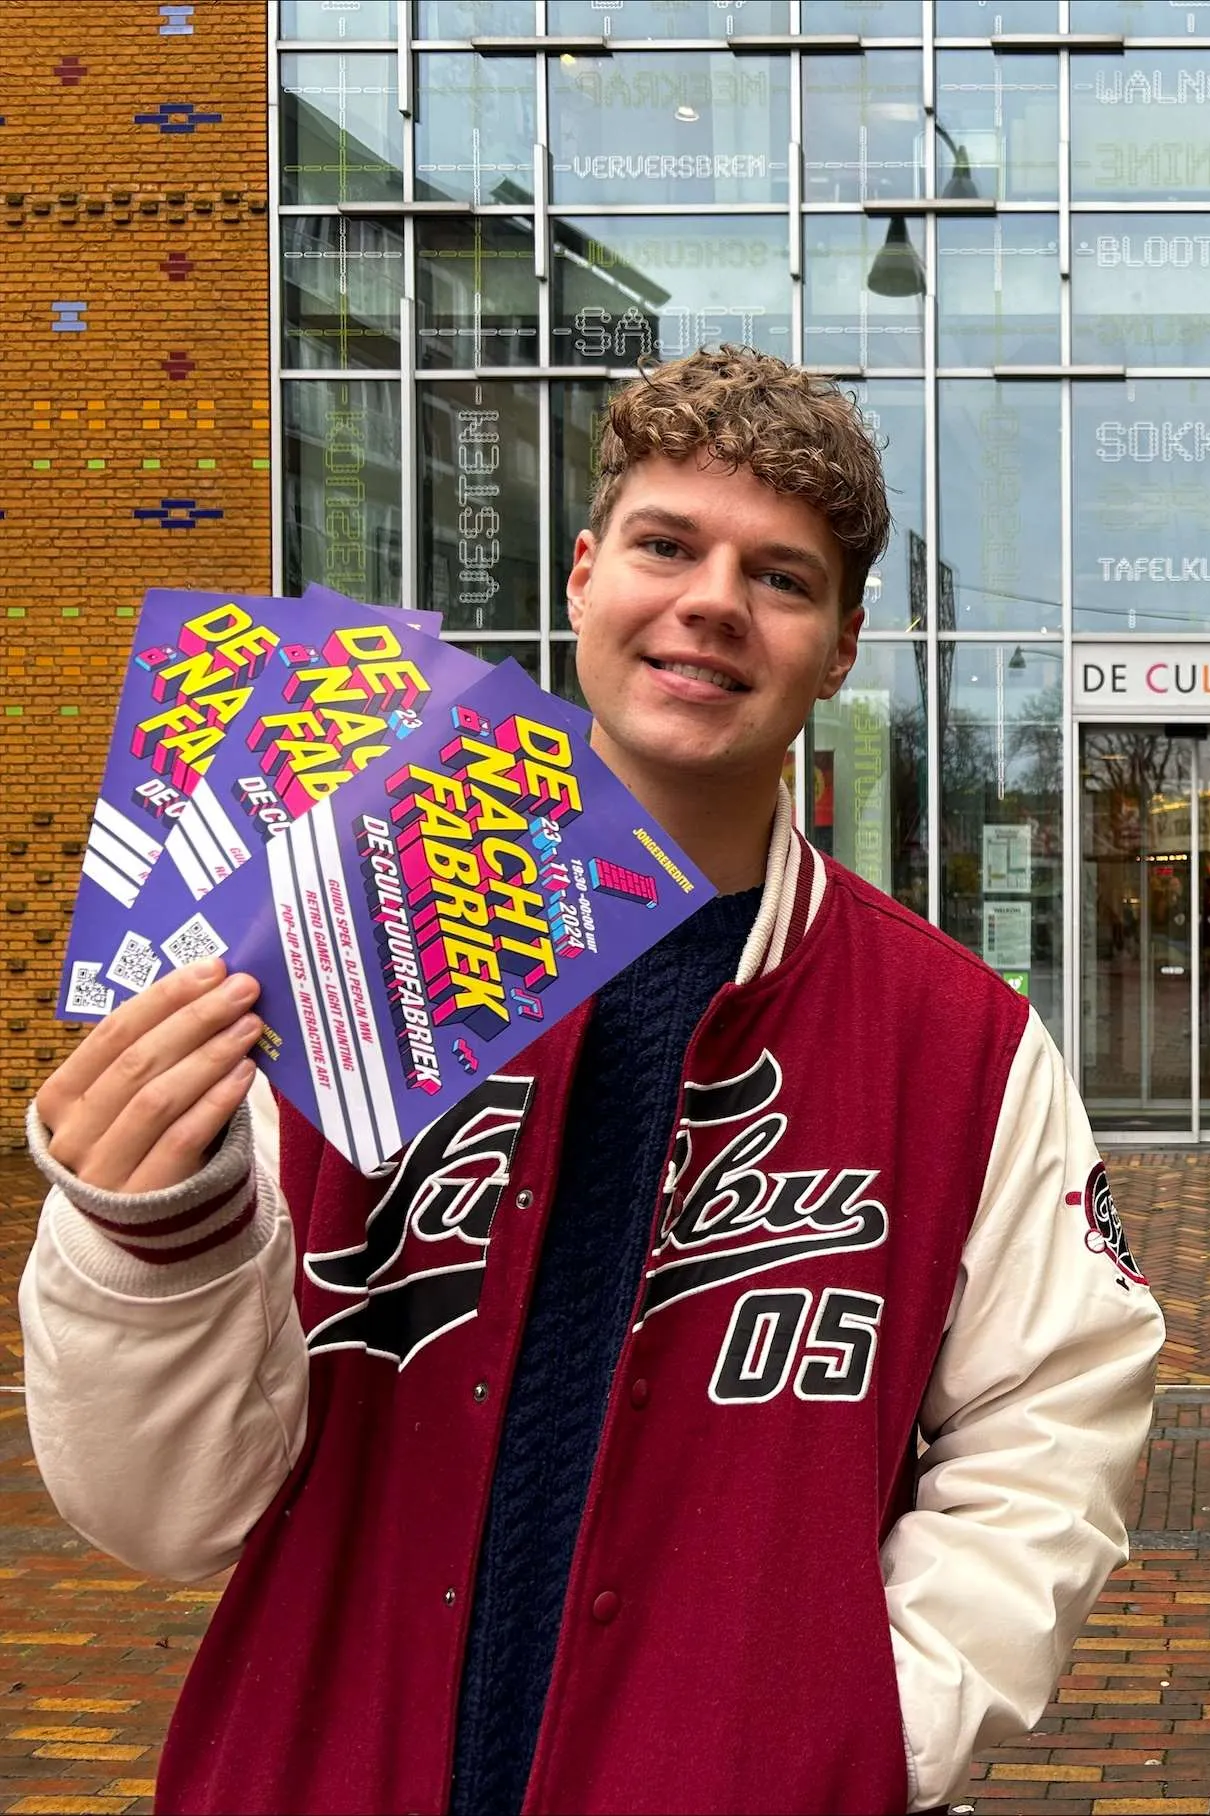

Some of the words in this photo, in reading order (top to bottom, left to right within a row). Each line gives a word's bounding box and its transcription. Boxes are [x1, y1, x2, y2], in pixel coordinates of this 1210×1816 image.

[573, 155, 767, 179] VERVERSBREM
[458, 410, 500, 603] VESTEN
[180, 603, 281, 670] DE
[334, 626, 432, 697] DE
[1083, 663, 1128, 692] DE
[515, 714, 583, 813] DE
[460, 735, 559, 977] NACHT
[571, 858, 587, 892] 19:30
[633, 827, 695, 894] JONGERENEDITIE
[306, 889, 323, 929] RETRO
[328, 878, 345, 916] GUIDO
[408, 764, 511, 1023] FABRIEK
[314, 931, 333, 974] GAMES
[336, 916, 353, 949] SPEK
[345, 959, 359, 976] DJ
[280, 903, 300, 949] POP-UP
[290, 949, 307, 981] ACTS
[299, 991, 326, 1066] INTERACTIVE
[316, 1066, 331, 1090] ART
[325, 983, 342, 1018] LIGHT
[350, 978, 368, 1019] PEPIJN
[333, 1019, 355, 1072] PAINTING
[359, 1020, 374, 1044] MW
[708, 1287, 885, 1405] 05
